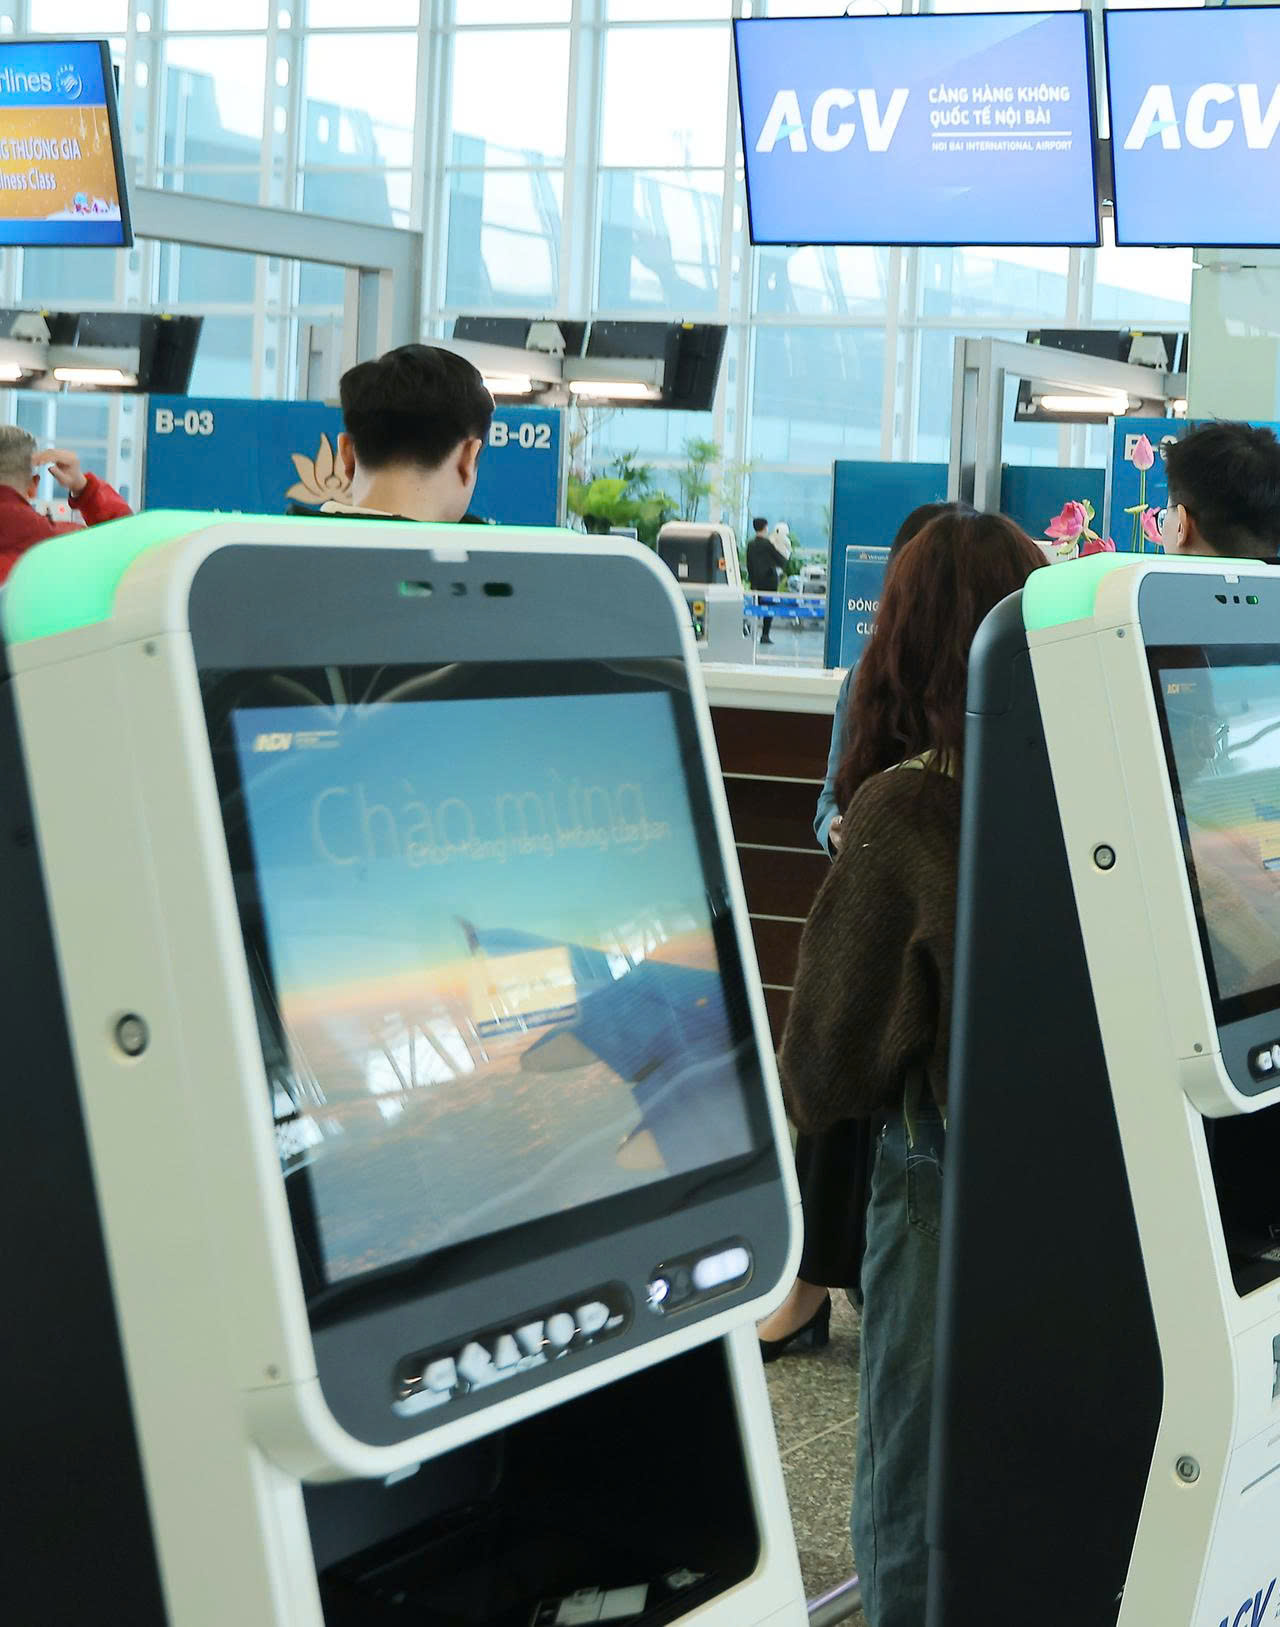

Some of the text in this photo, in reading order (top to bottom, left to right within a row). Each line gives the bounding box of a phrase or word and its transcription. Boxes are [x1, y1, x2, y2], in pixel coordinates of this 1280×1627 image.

[928, 83, 1071, 103] CẢNG HÀNG KHÔNG
[755, 88, 910, 152] ACV
[930, 104, 1051, 128] QUỐC TẾ NỘI BÀI
[62, 138, 82, 160] GIA
[949, 141, 964, 151] BAI
[966, 140, 1033, 151] INTERNATIONAL
[1036, 140, 1073, 151] AIRPORT
[28, 168, 56, 190] Class
[156, 408, 214, 436] B-03
[489, 421, 551, 449] B-02
